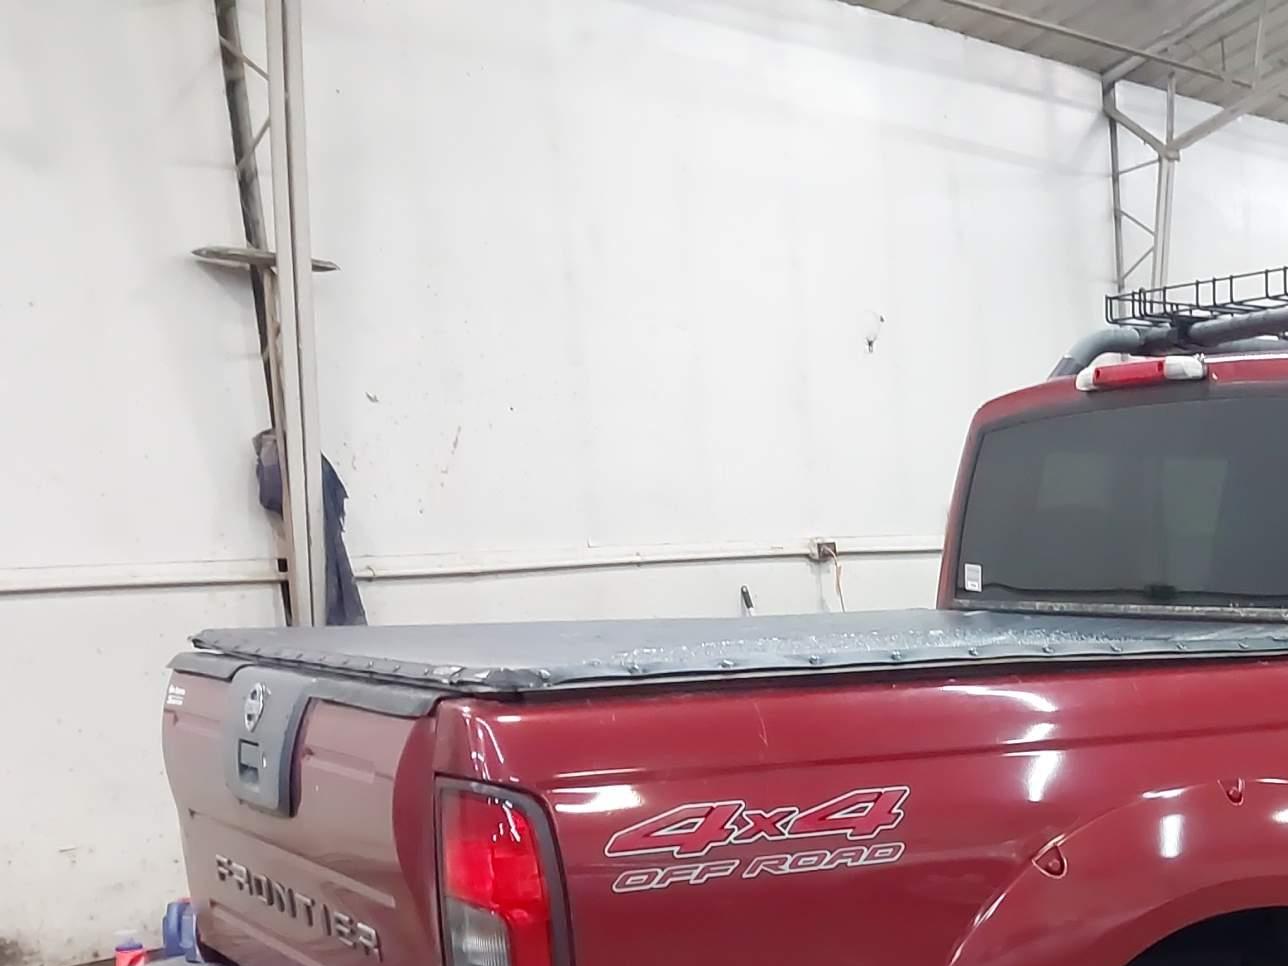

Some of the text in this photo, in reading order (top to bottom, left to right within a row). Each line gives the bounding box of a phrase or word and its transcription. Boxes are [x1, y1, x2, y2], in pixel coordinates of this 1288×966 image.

[605, 786, 910, 858] 4x4
[612, 842, 906, 893] OFF ROAD
[215, 854, 384, 963] FRONTIER
